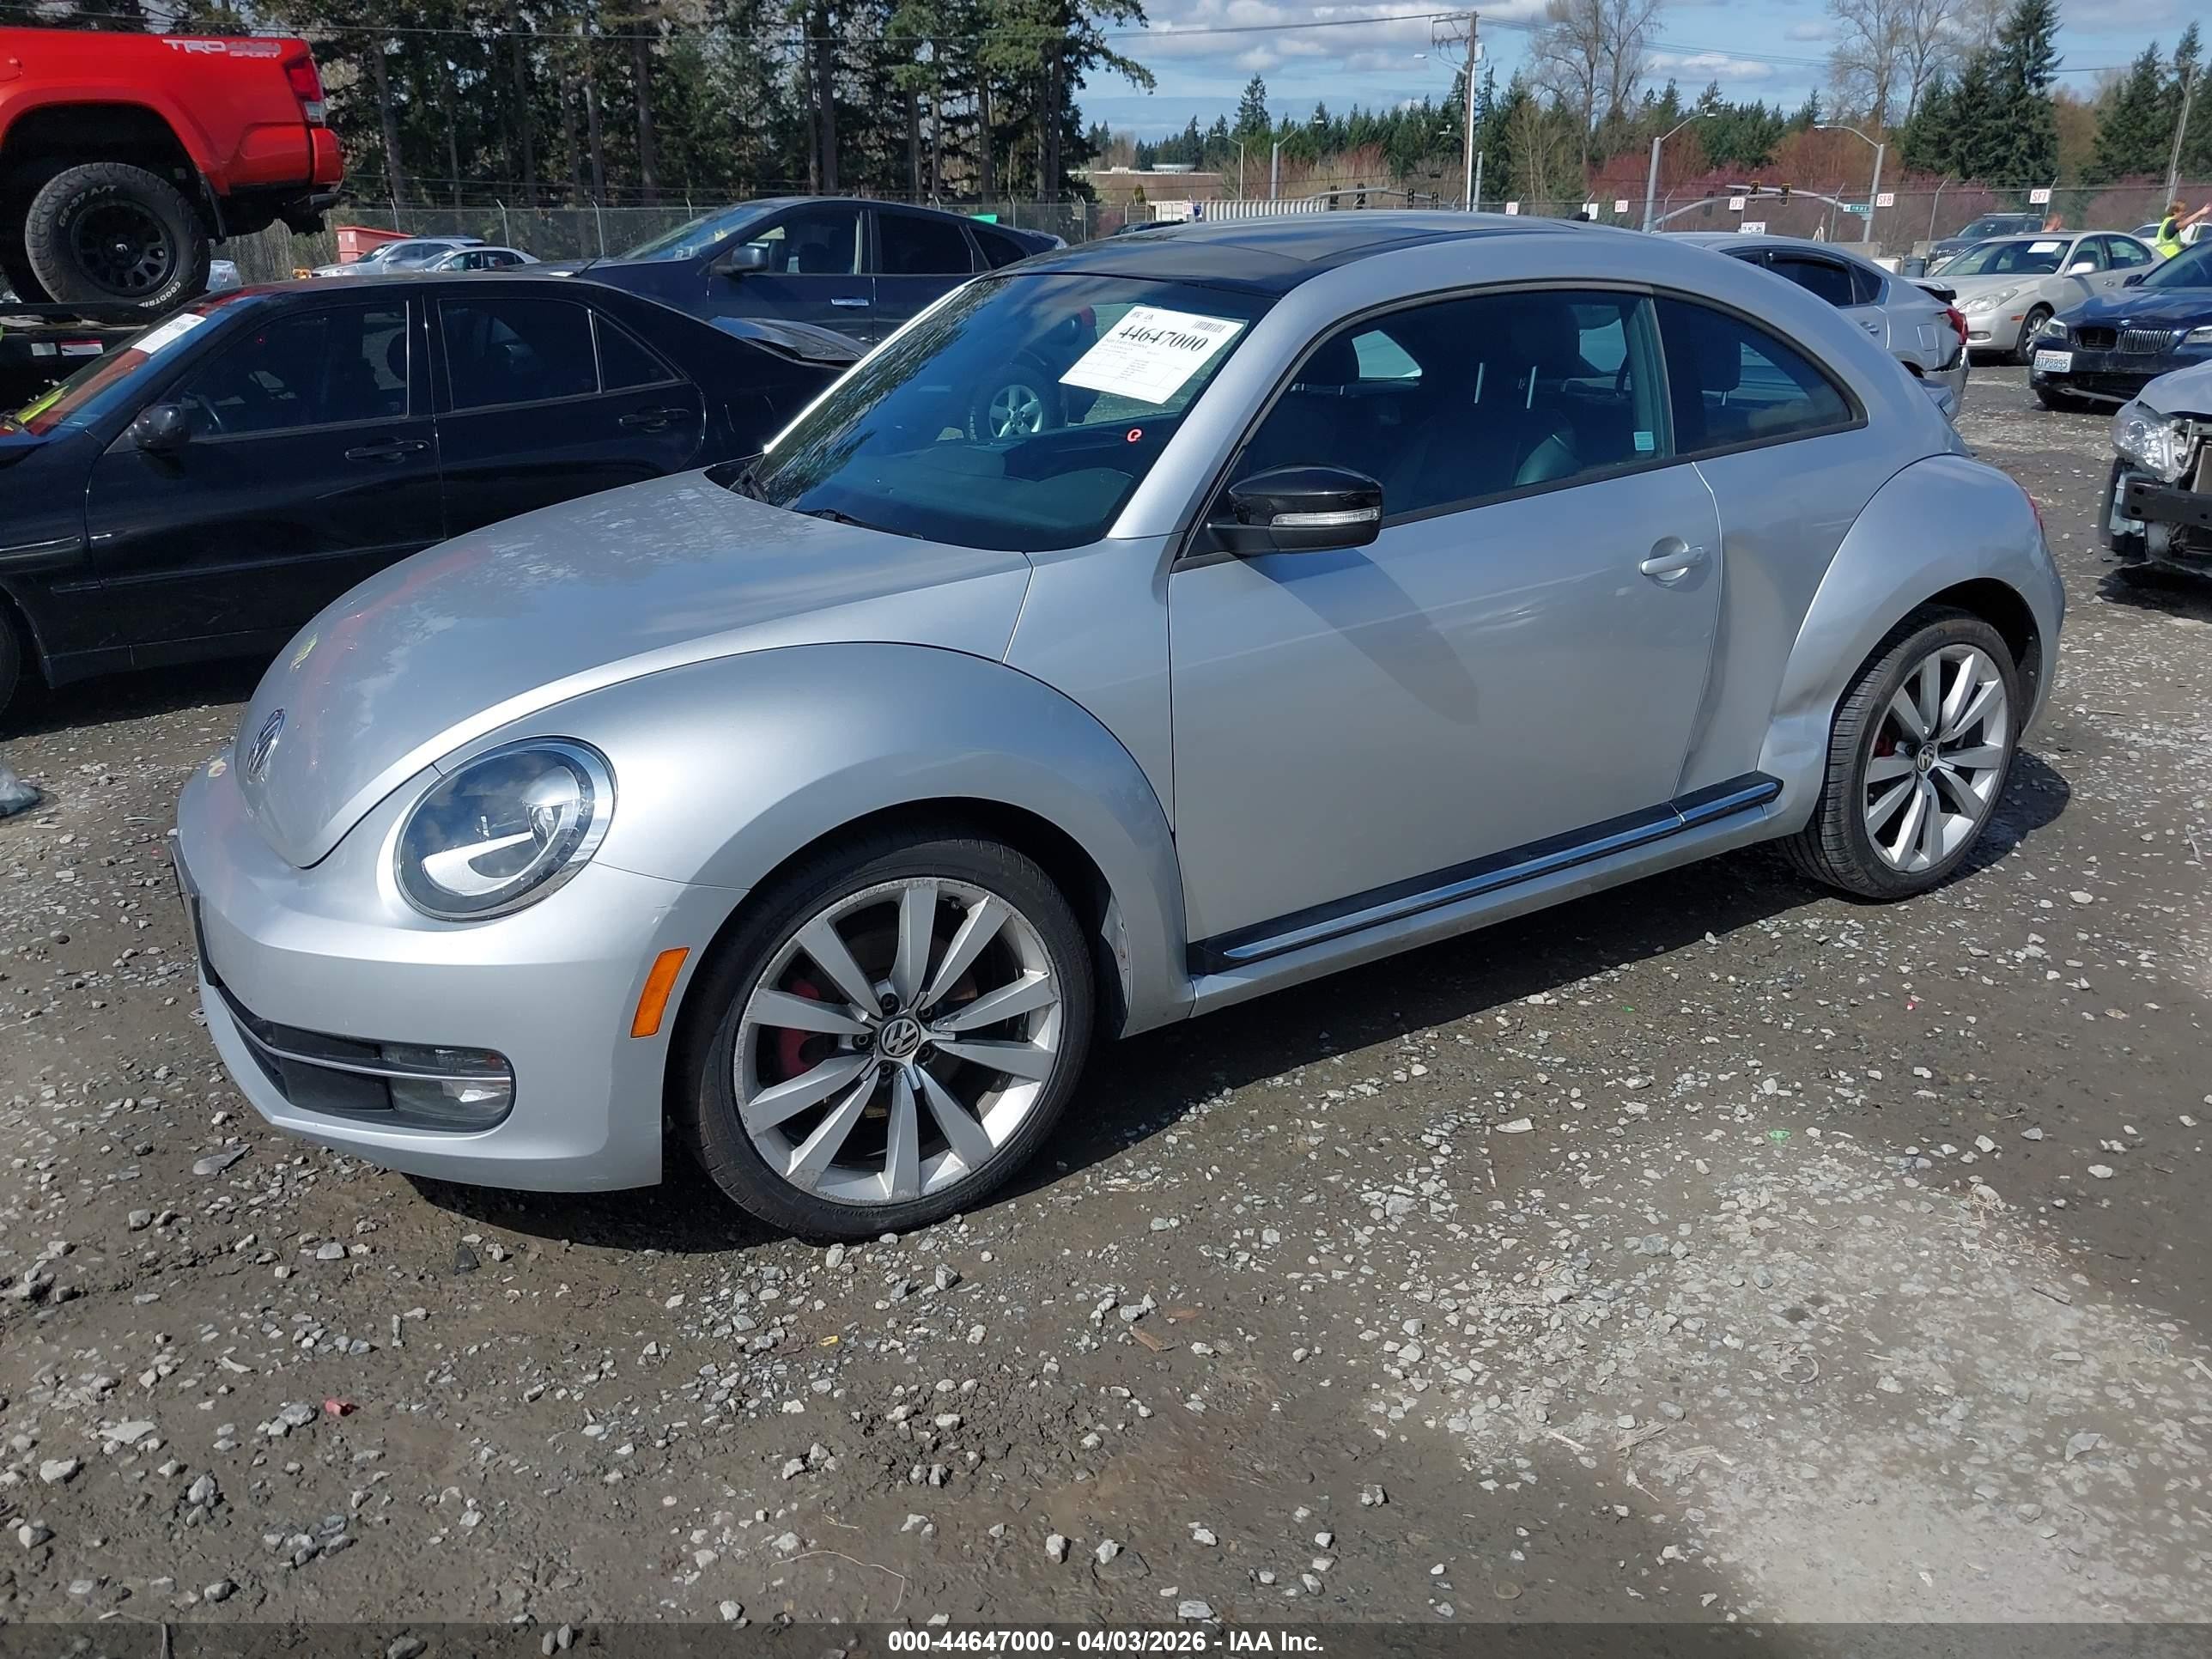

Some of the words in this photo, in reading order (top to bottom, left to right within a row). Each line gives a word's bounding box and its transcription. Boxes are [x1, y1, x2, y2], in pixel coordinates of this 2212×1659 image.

[162, 39, 227, 54] TRD
[1730, 198, 1744, 209] SF9
[1878, 191, 1893, 205] SF8
[2032, 191, 2048, 202] SF7
[1119, 325, 1209, 352] 44647000
